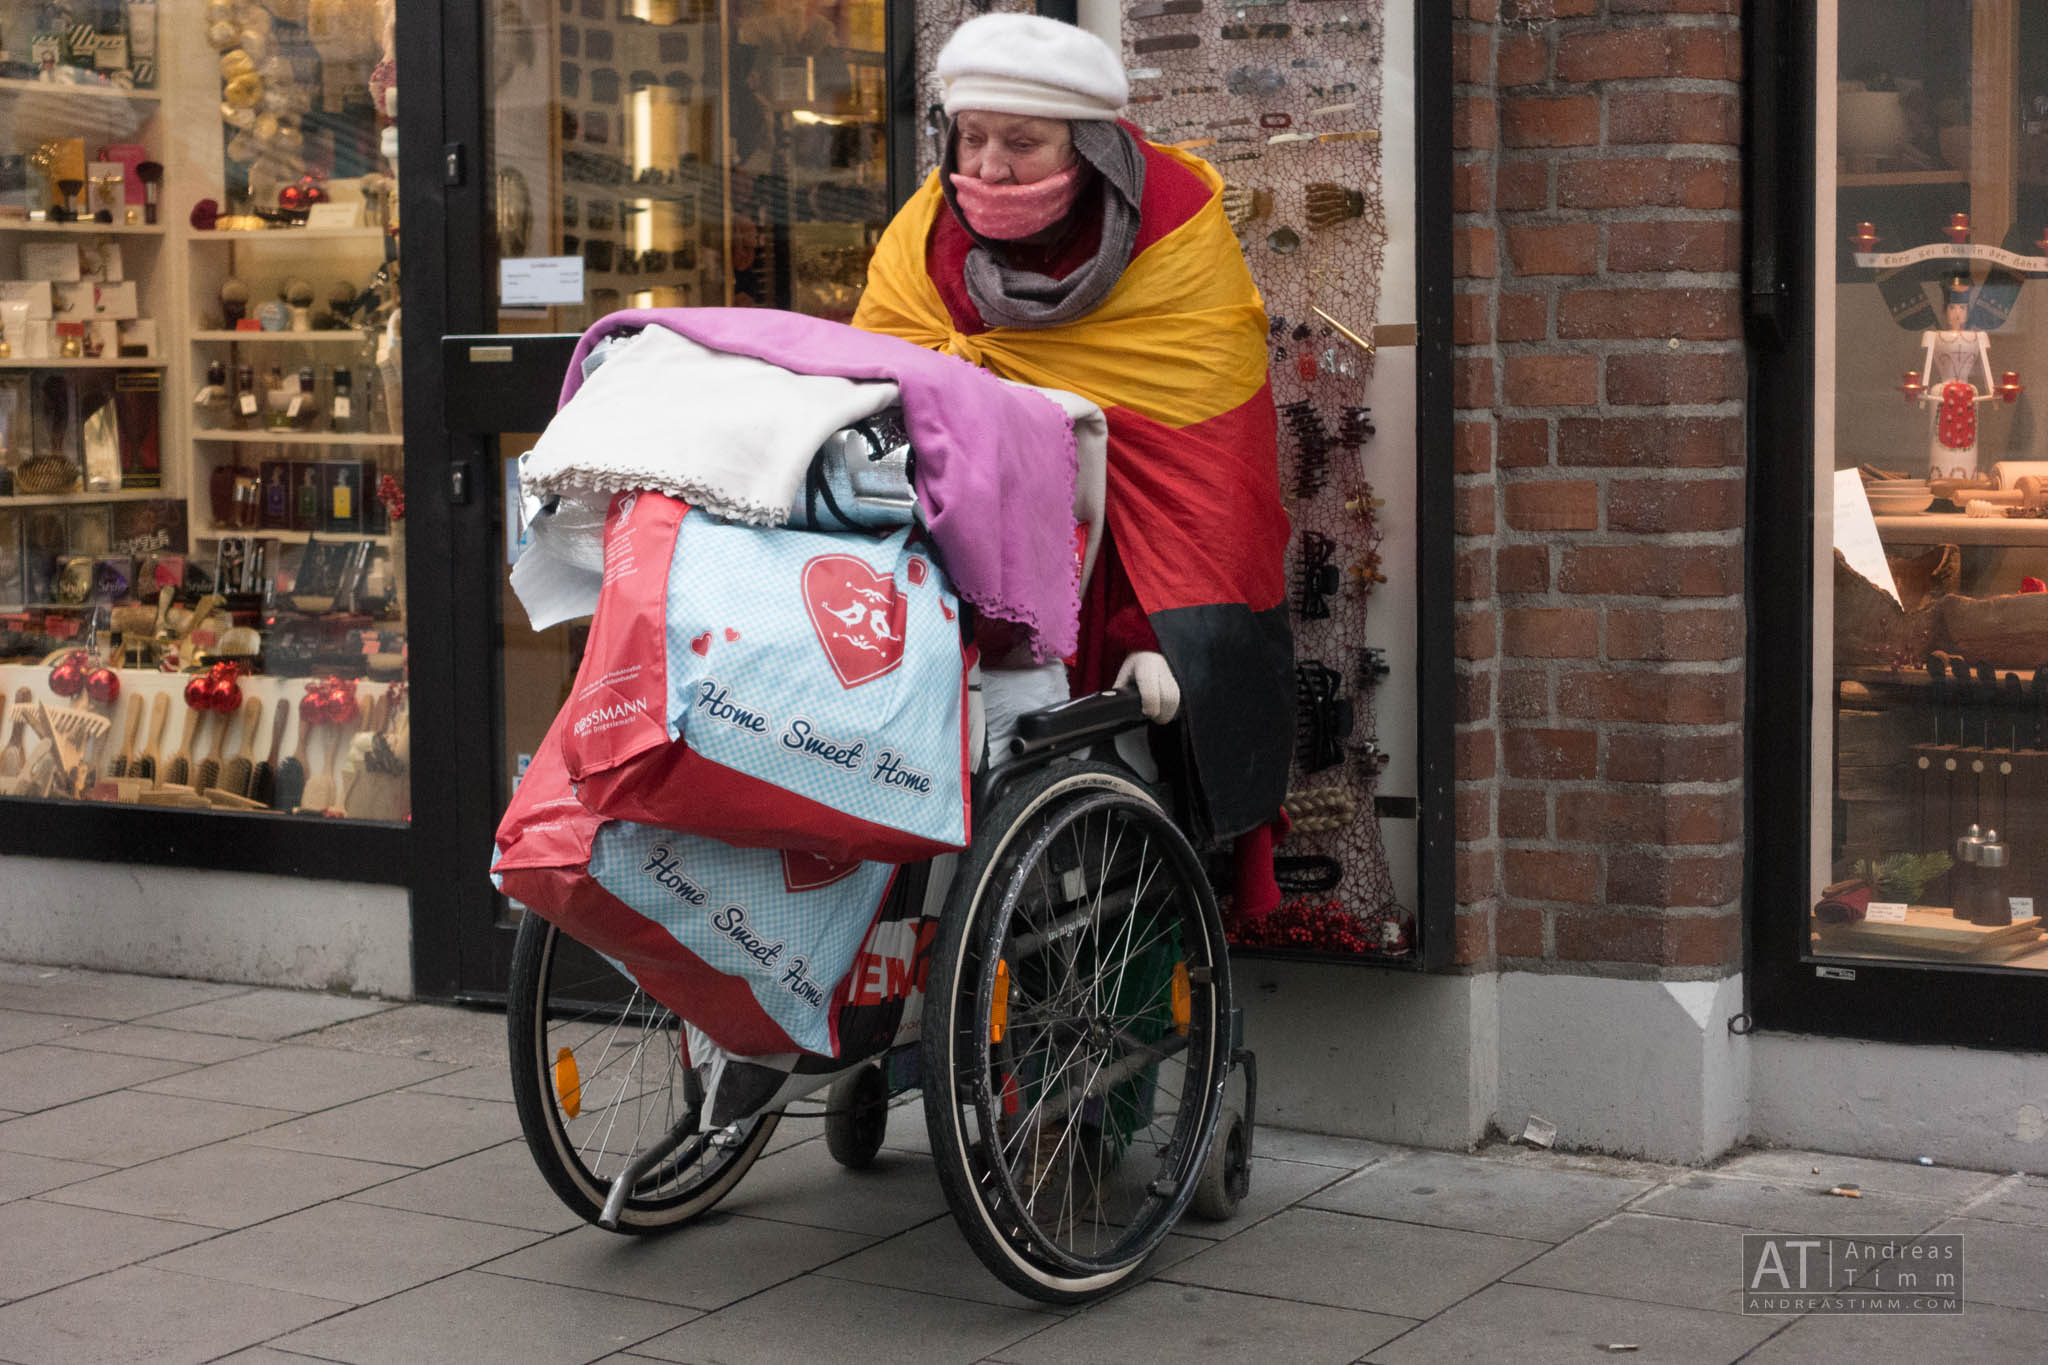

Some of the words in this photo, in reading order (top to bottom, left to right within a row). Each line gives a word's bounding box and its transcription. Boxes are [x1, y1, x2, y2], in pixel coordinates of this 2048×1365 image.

[698, 681, 767, 733] Home
[783, 719, 864, 769] Sweet
[873, 752, 931, 793] Home
[644, 848, 706, 905] Home
[713, 907, 784, 967] Sweet
[781, 959, 823, 1007] Home
